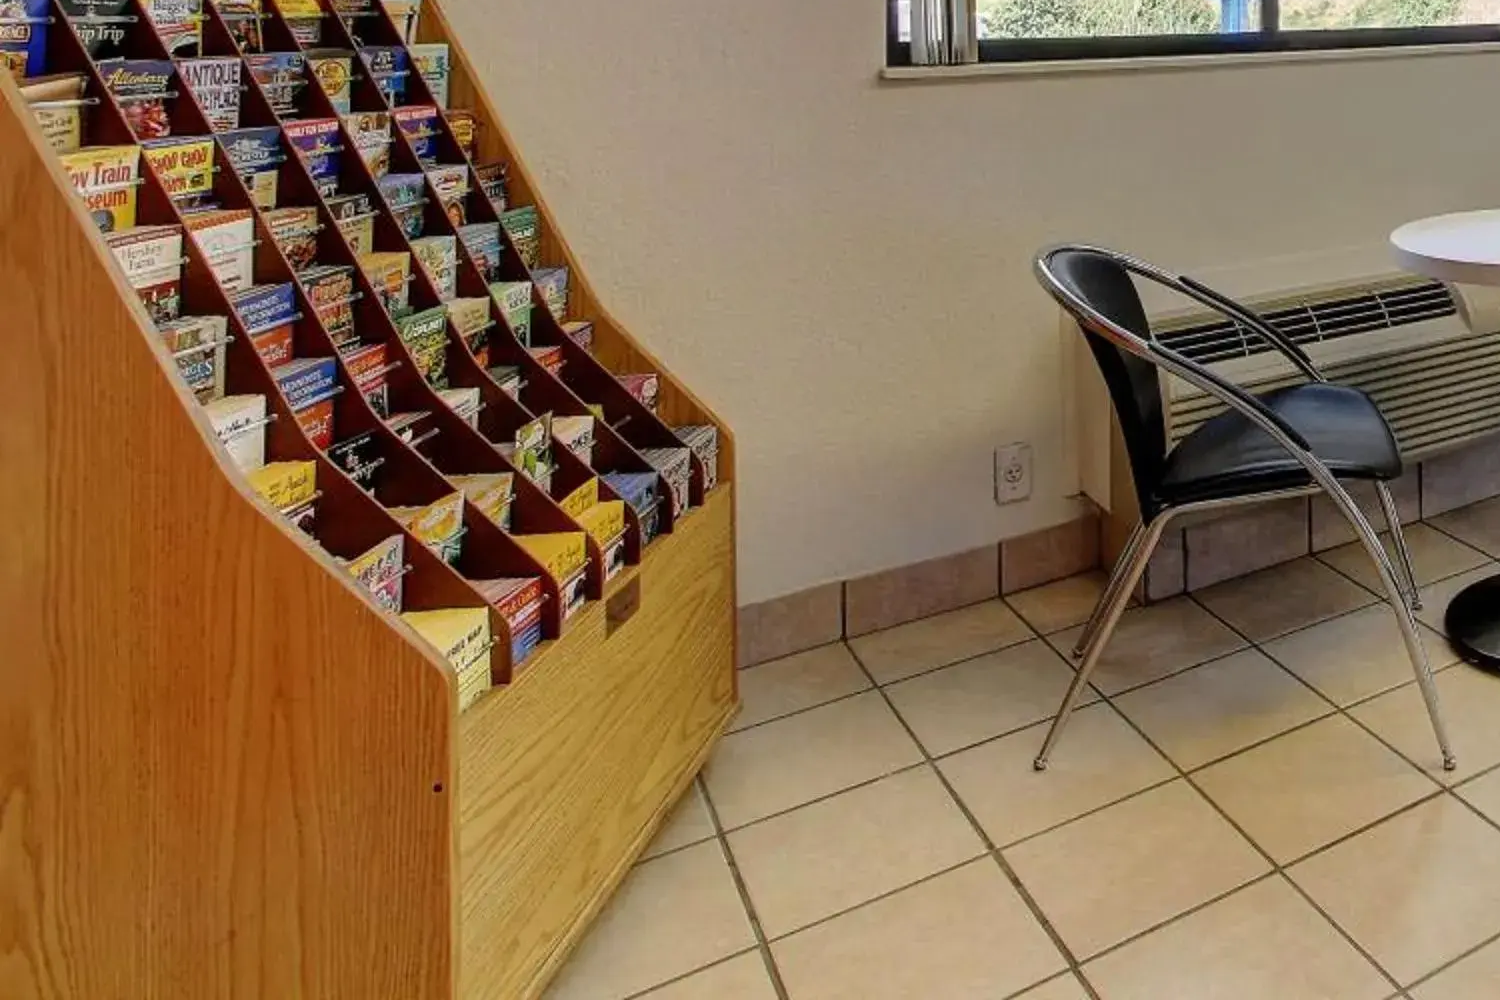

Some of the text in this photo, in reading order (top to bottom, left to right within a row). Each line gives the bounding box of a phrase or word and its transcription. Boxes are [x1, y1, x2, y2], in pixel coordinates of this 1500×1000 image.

[96, 25, 125, 47] Trip
[92, 159, 132, 184] Train
[84, 189, 128, 210] seum
